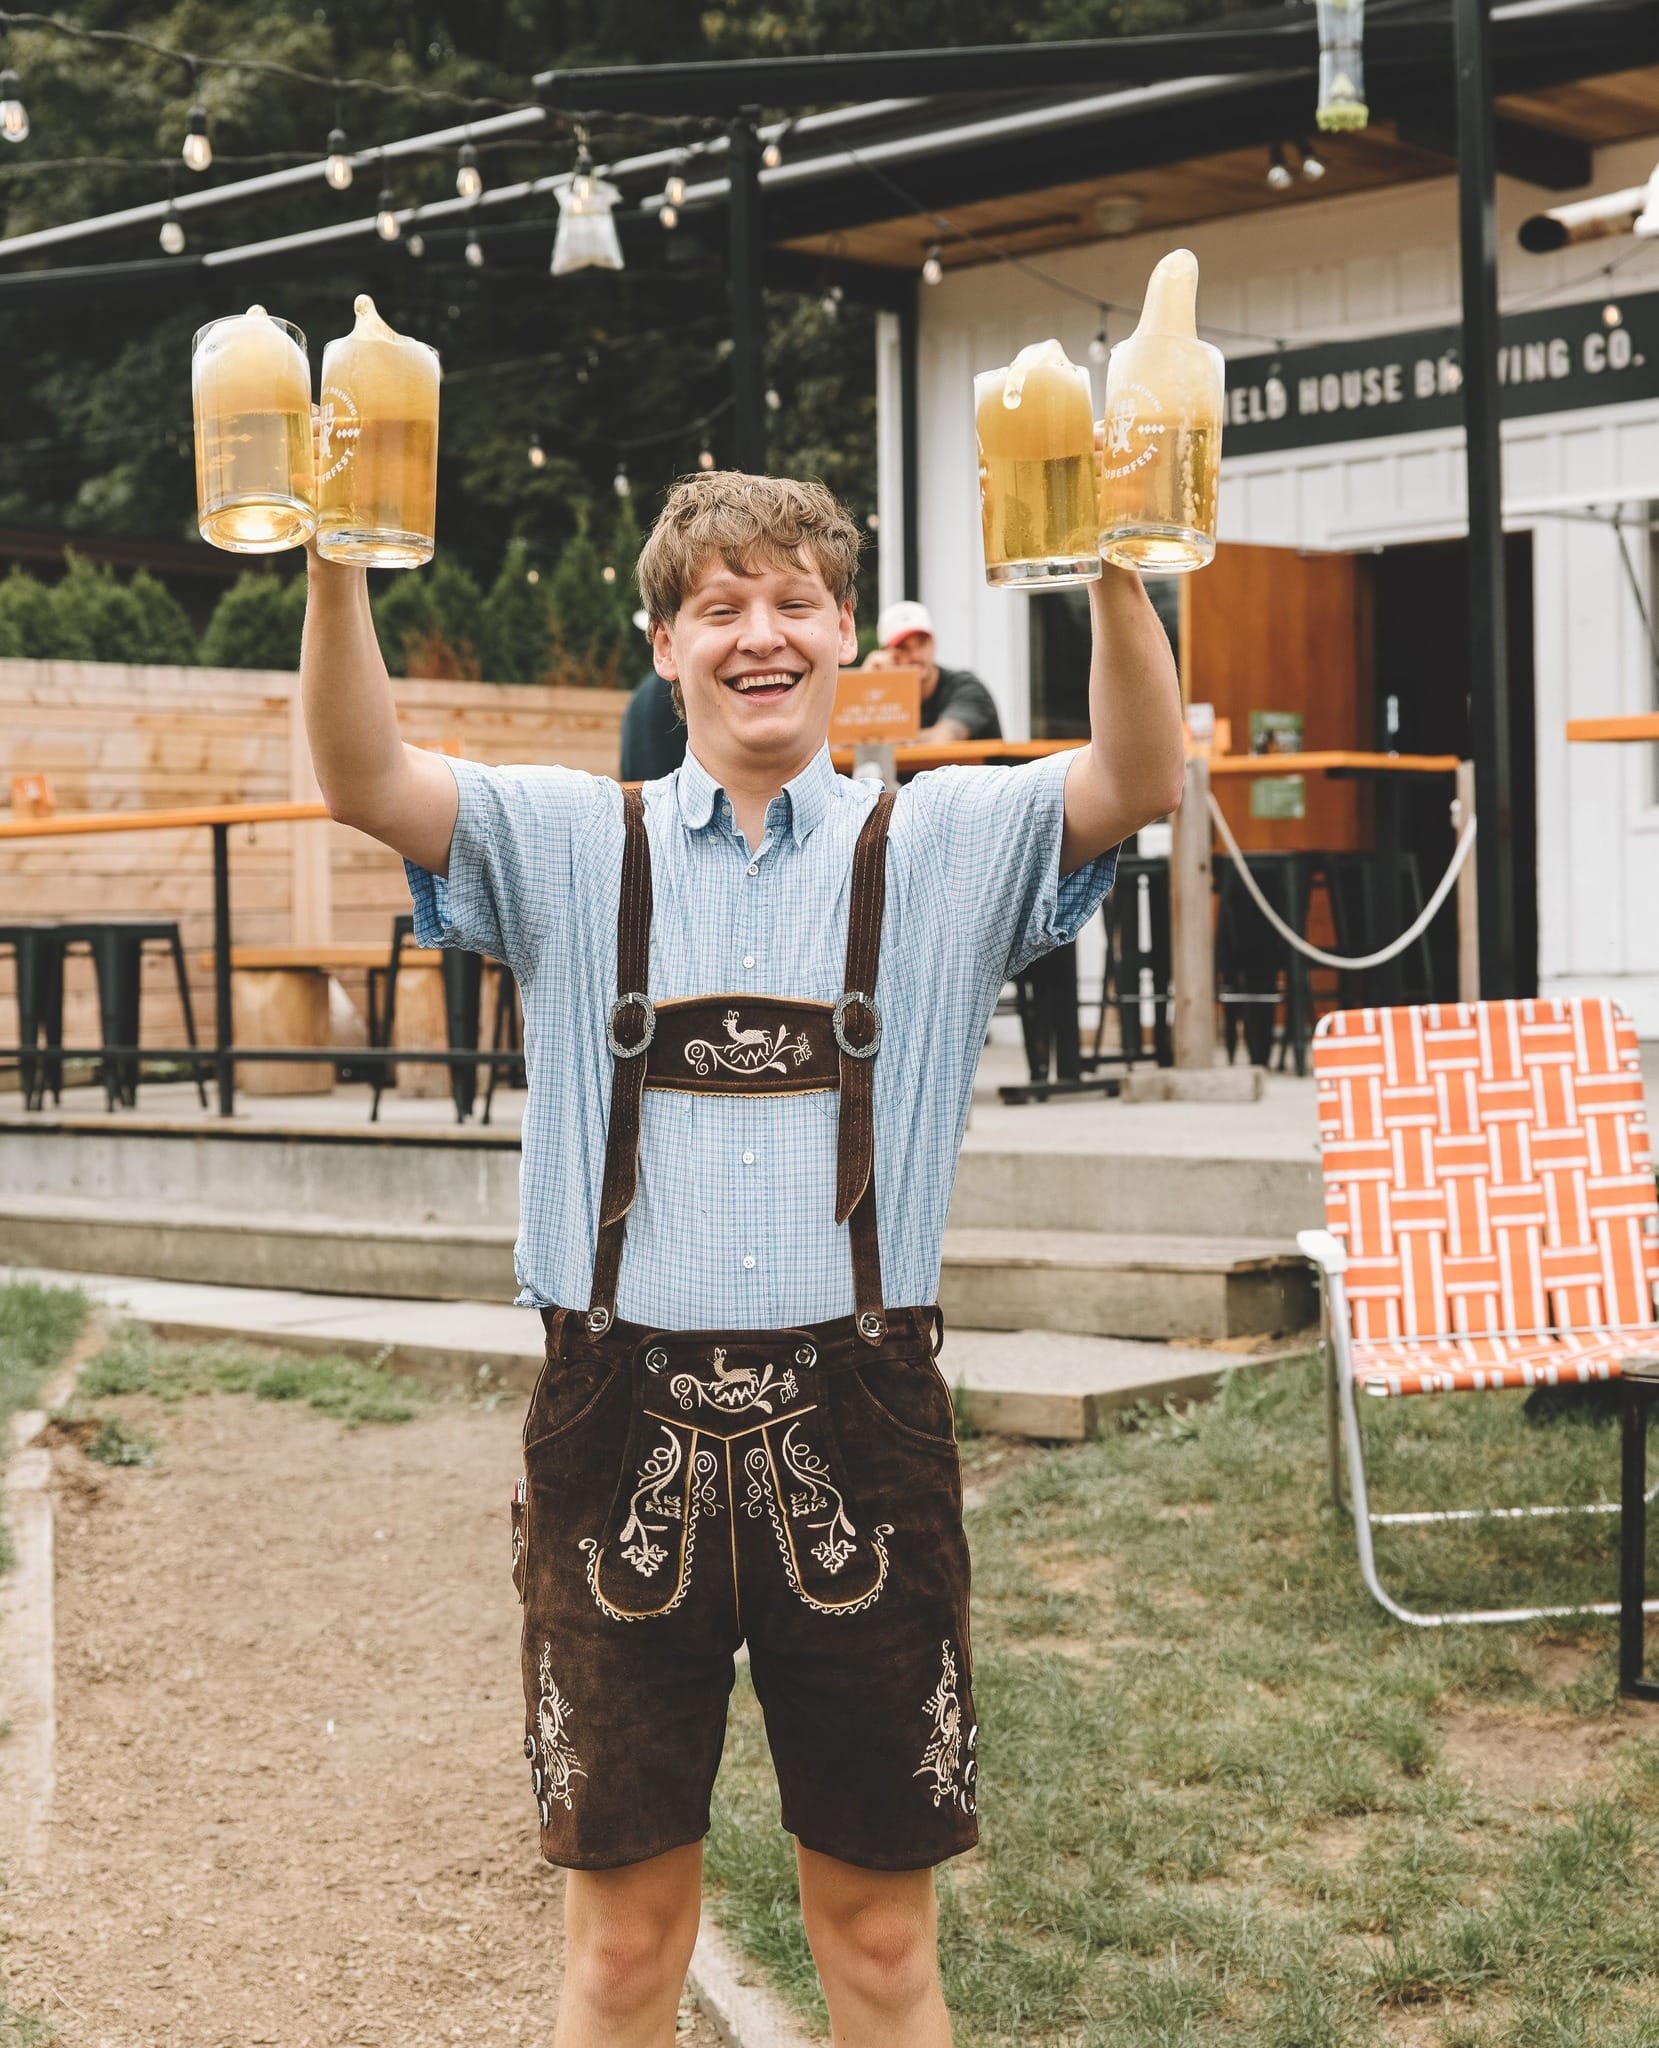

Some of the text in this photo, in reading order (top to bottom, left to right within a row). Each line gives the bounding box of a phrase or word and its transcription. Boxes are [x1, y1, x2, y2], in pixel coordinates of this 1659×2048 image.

[1223, 329, 1645, 428] IELD HOUSE BRING CO.
[319, 447, 353, 484] ERFEST
[1104, 443, 1158, 480] OBERFEST
